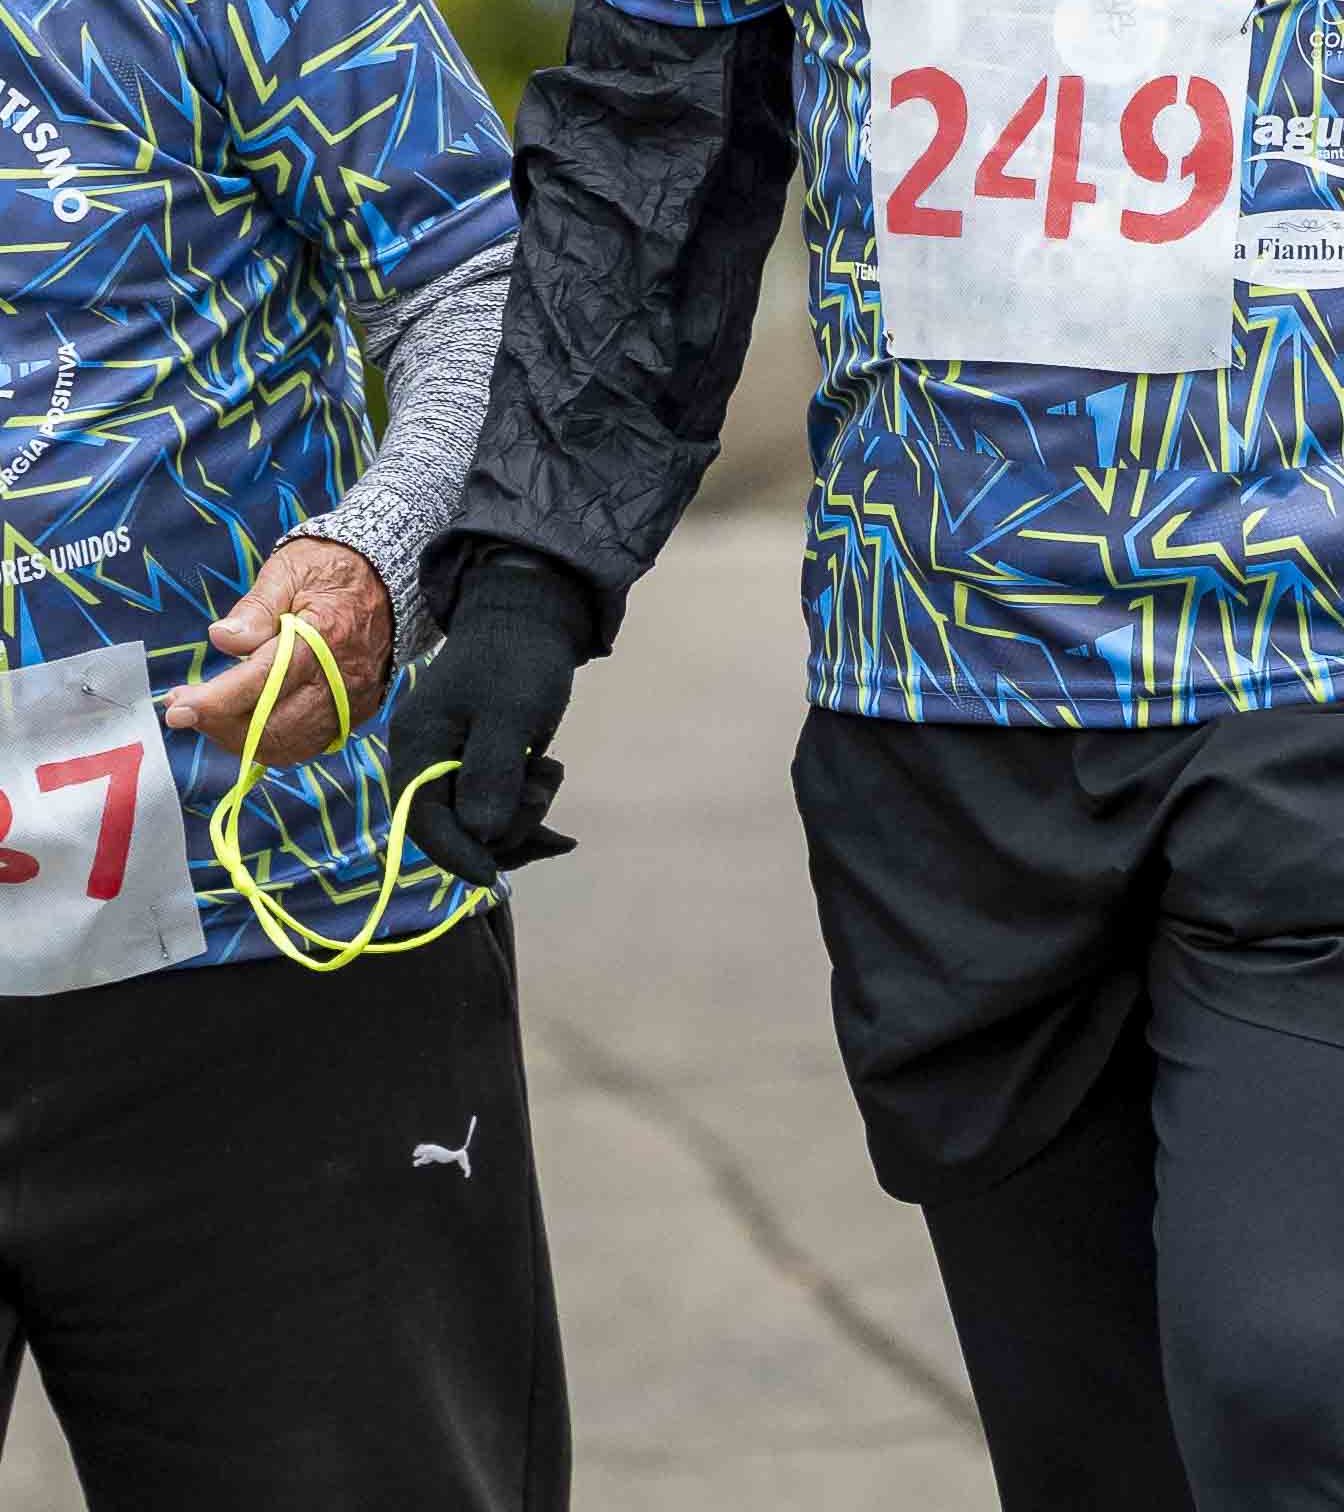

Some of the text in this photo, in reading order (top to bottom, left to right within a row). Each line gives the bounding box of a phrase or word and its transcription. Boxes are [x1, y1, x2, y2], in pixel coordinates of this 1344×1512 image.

[885, 65, 1235, 244] 249
[39, 341, 79, 437] POSITIVA
[49, 525, 132, 575] UNIDOS
